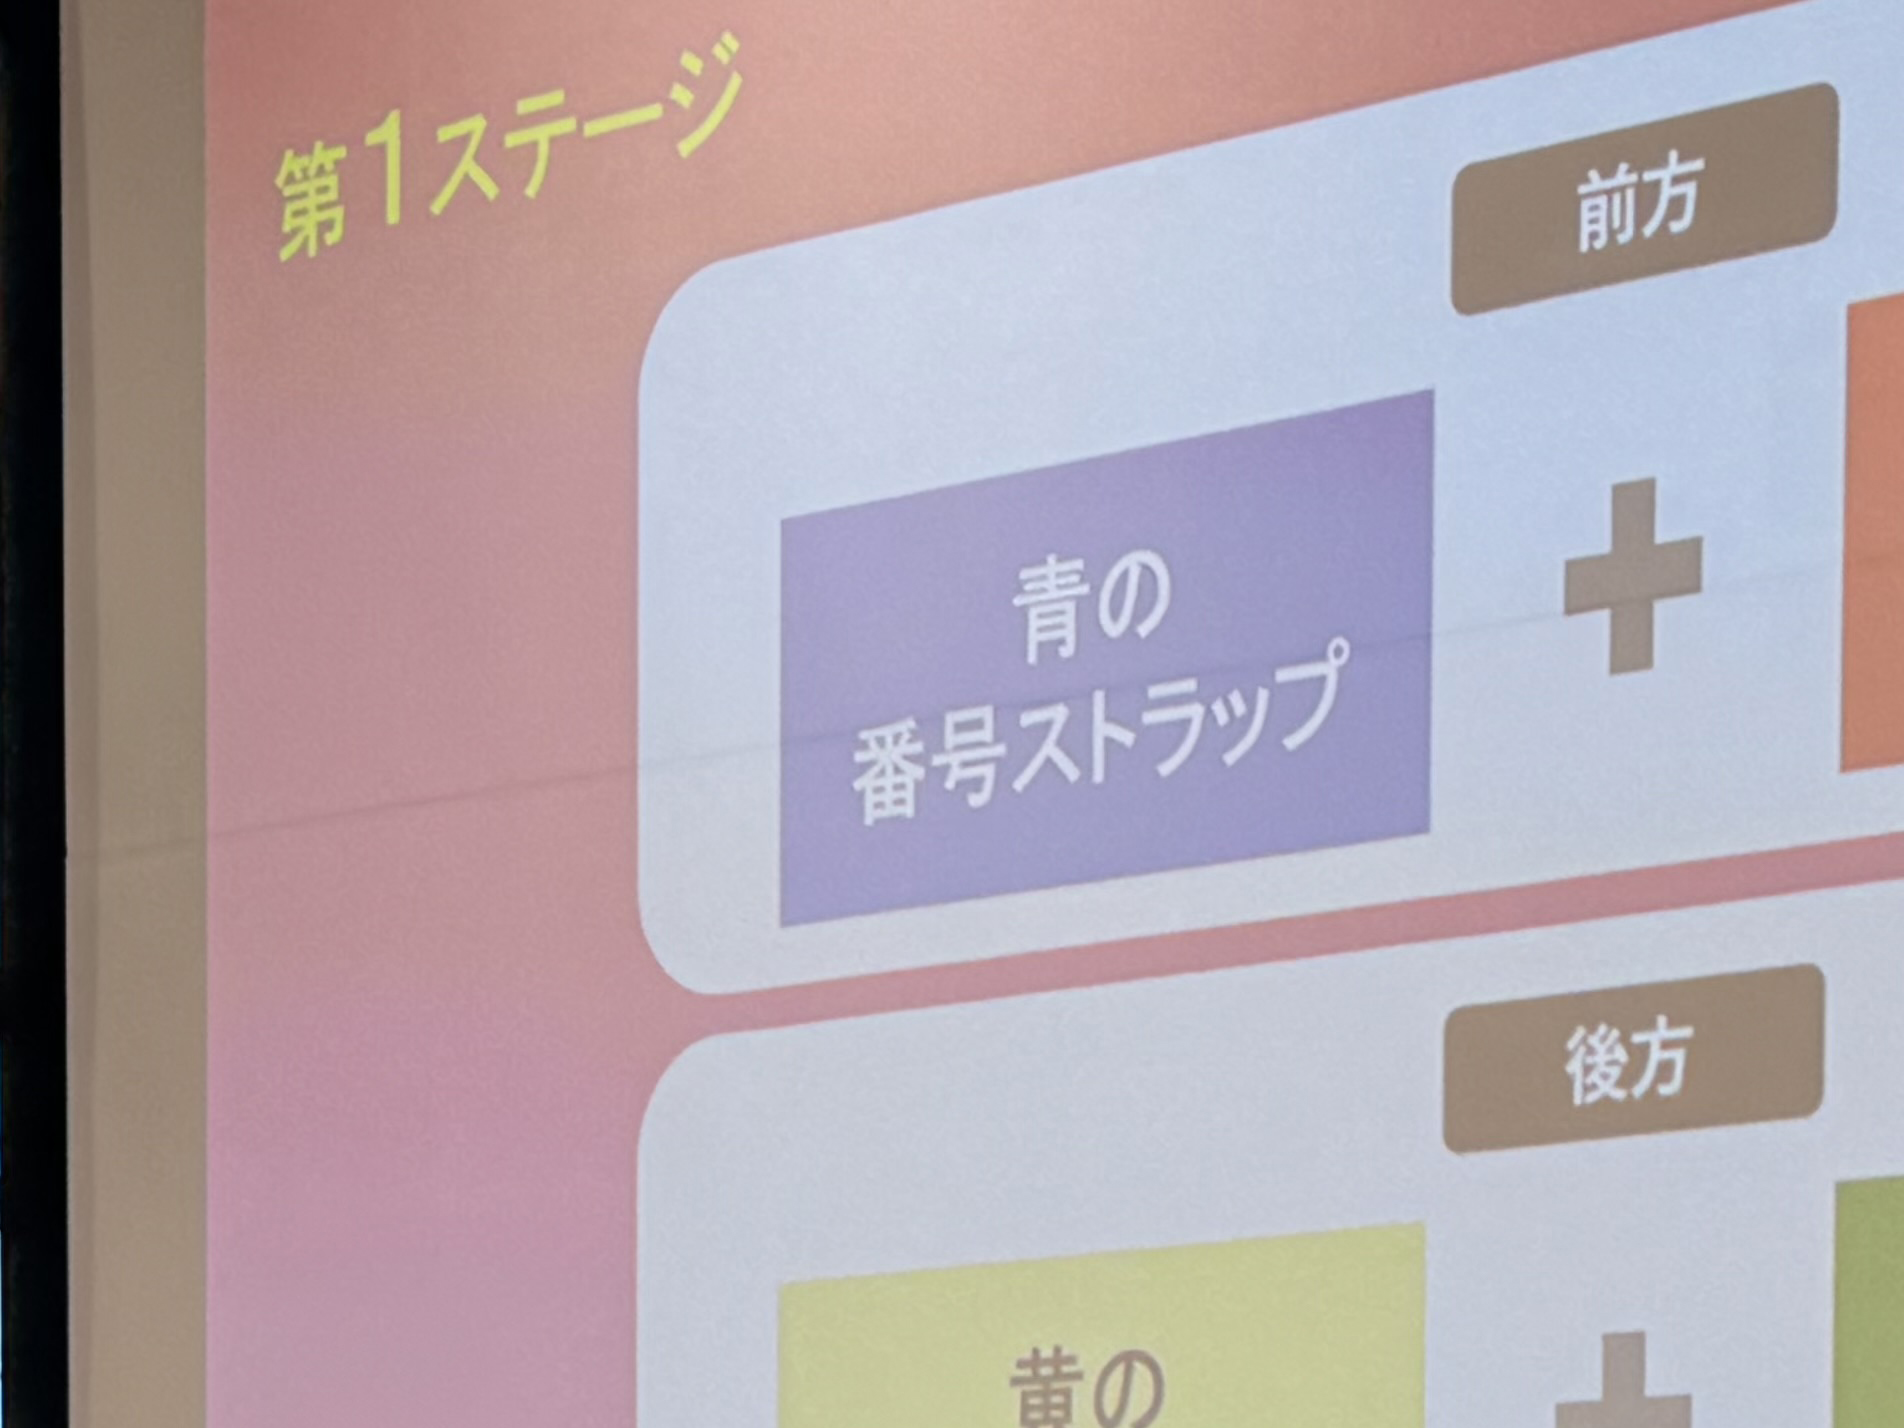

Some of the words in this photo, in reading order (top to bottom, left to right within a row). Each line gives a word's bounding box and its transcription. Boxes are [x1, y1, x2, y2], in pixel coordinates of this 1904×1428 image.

[273, 31, 743, 262] 第1ステージ
[1576, 148, 1705, 253] 前方
[1013, 549, 1171, 665] 青の
[852, 635, 1351, 825] 番号ストラップ
[1564, 1015, 1693, 1108] 後方
